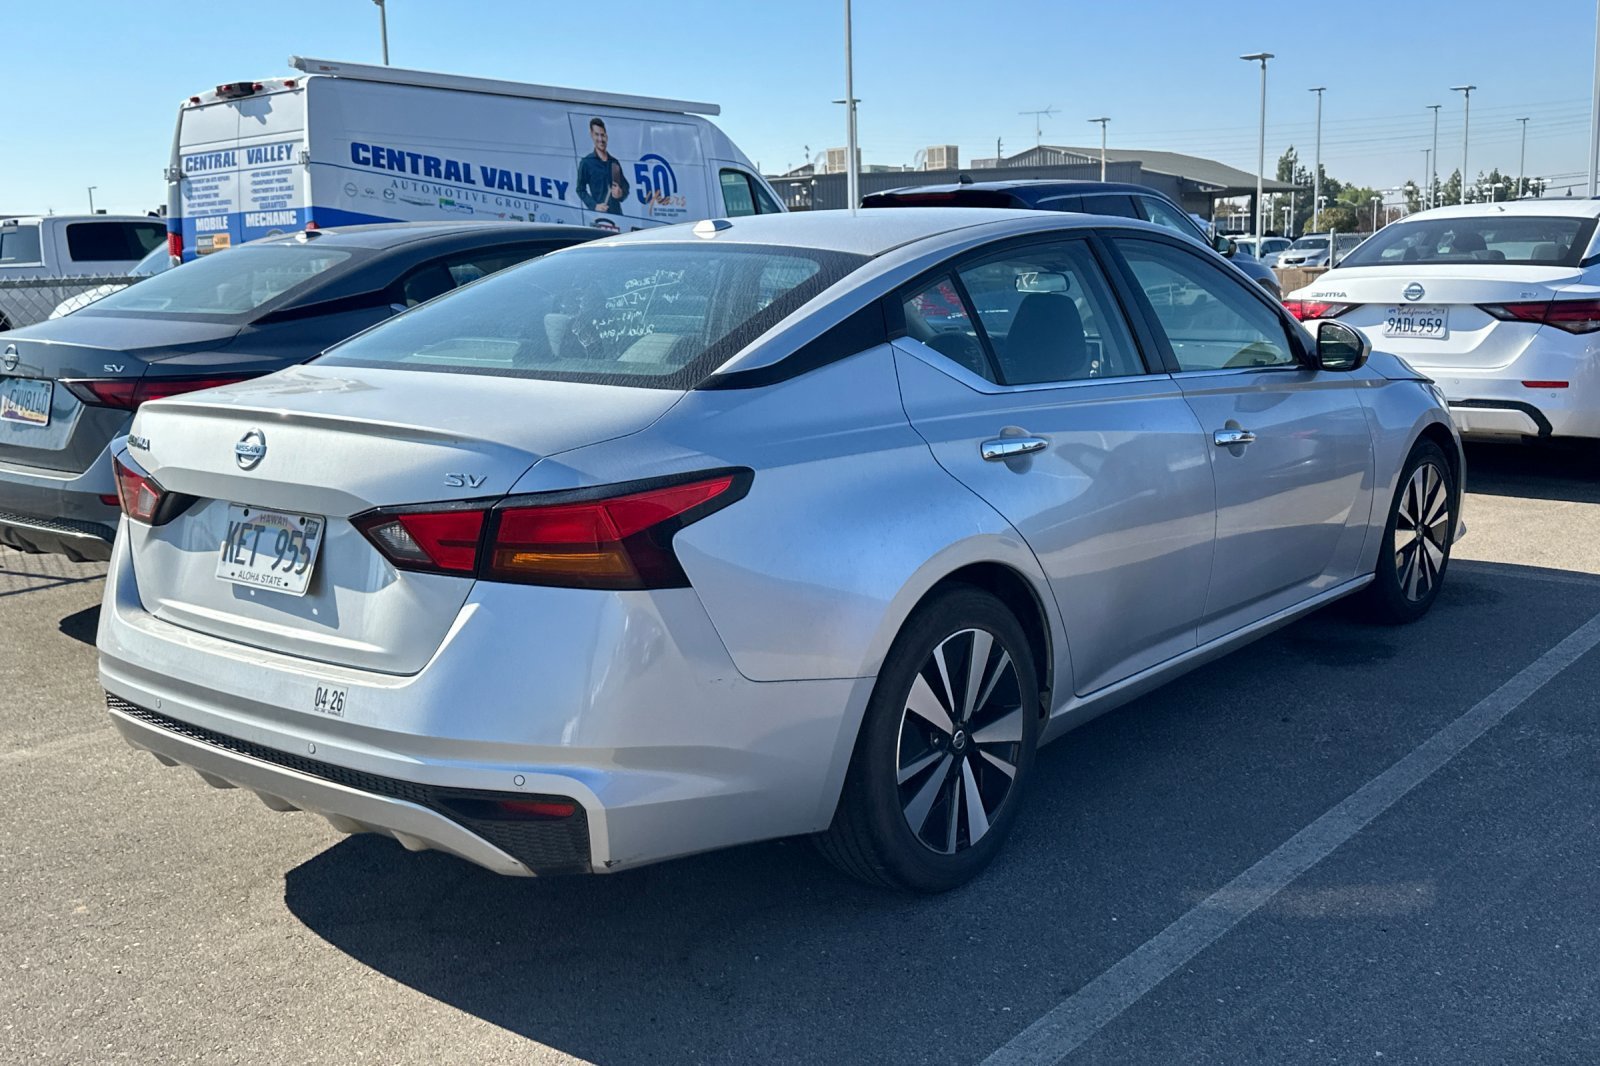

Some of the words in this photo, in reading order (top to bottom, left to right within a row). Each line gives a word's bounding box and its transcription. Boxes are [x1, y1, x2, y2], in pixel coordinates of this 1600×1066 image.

[186, 151, 237, 172] CENTRAL
[246, 144, 293, 165] VALLEY
[351, 142, 476, 185] CENTRAL
[480, 165, 569, 200] VALLEY
[633, 163, 670, 205] 50
[390, 179, 488, 203] AUTOMOTIVE
[495, 197, 540, 212] GROUP
[196, 216, 229, 232] MOBILE
[245, 210, 297, 227] MECHANIC
[1397, 306, 1435, 317] California
[1387, 317, 1442, 333] 9ADL959
[104, 364, 125, 373] SV
[236, 443, 261, 453] NISSAN
[444, 473, 488, 488] SV
[222, 520, 266, 567] KET
[271, 529, 316, 575] 955
[238, 570, 259, 582] ALOHA
[261, 574, 282, 586] STATE
